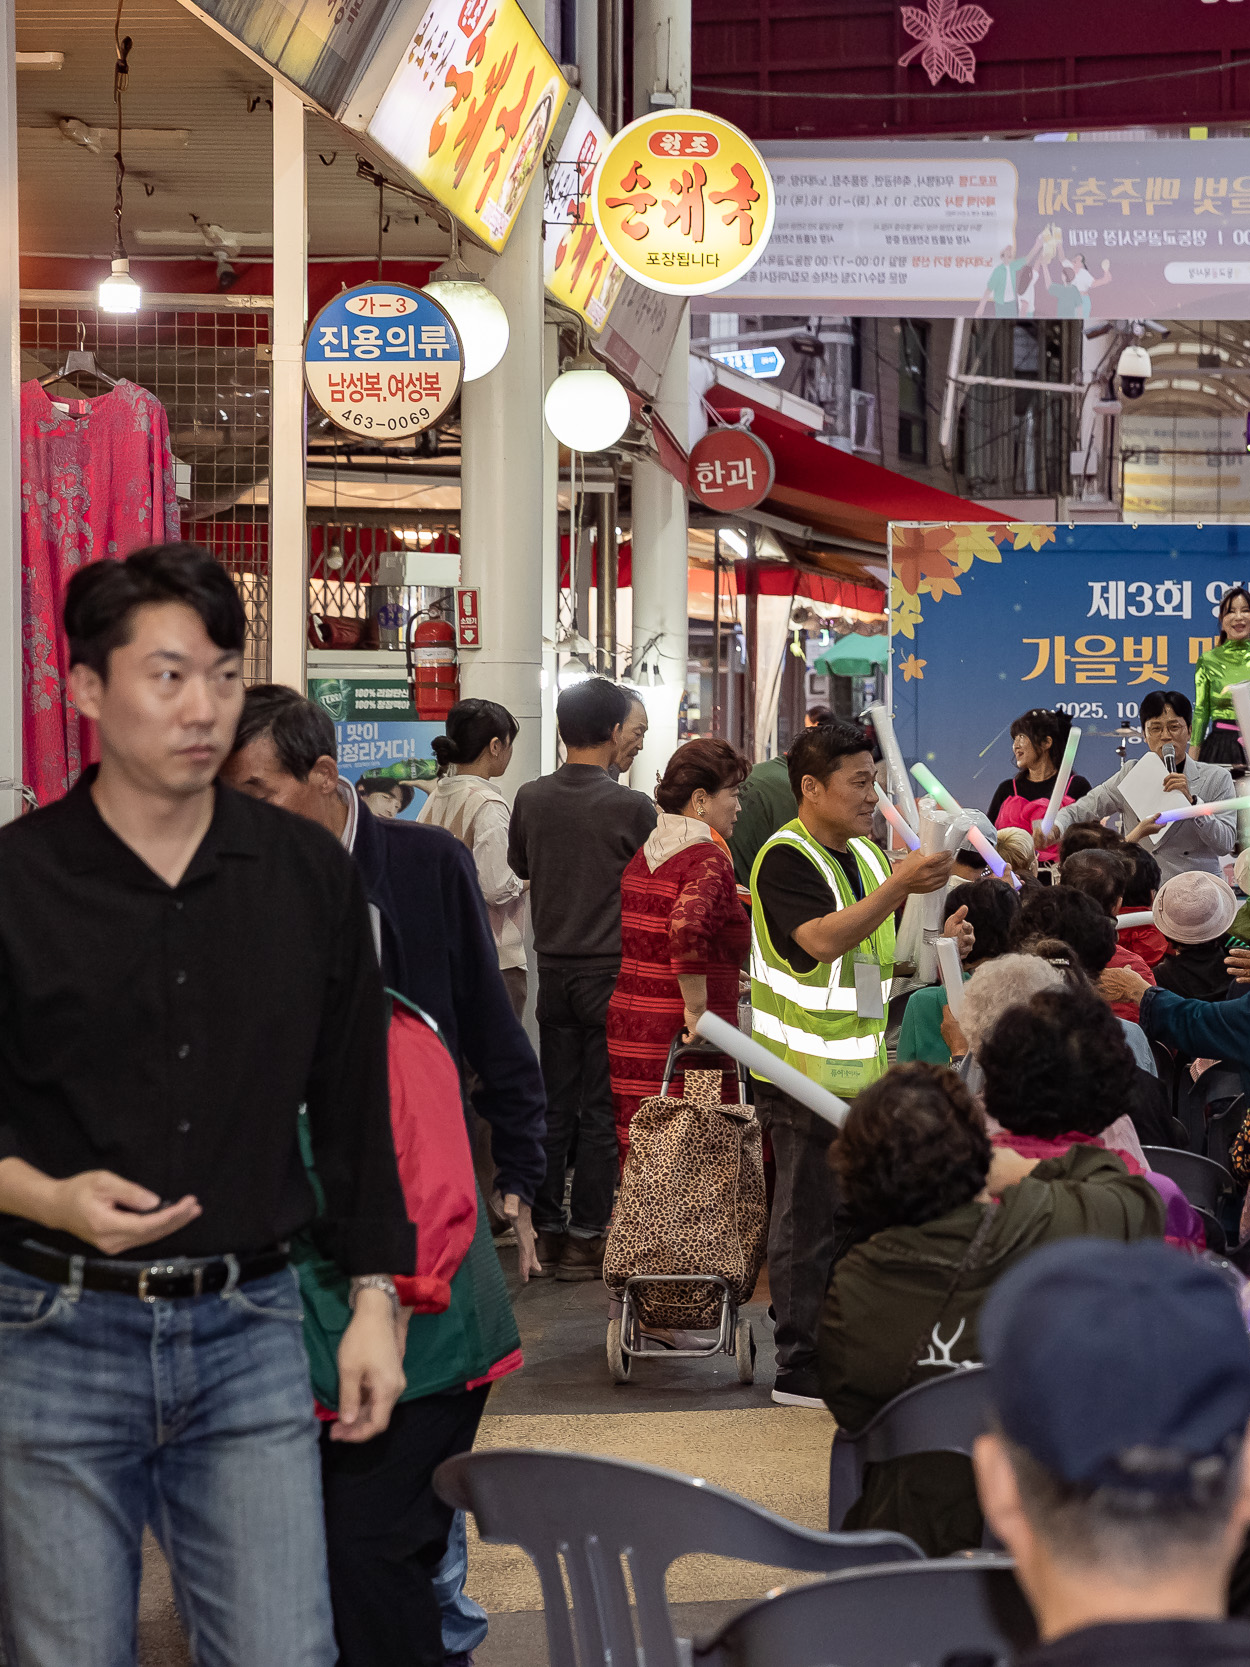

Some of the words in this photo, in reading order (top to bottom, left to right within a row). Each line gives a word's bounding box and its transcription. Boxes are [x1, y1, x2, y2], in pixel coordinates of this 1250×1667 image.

[659, 133, 709, 156] 원조
[605, 160, 760, 245] 순대국
[646, 252, 720, 268] 포장됩니다
[358, 296, 407, 315] 가-3
[318, 325, 450, 359] 진용의류
[341, 407, 430, 431] 463-0069
[695, 457, 757, 494] 한과
[1086, 580, 1192, 620] 제3회
[1021, 634, 1169, 686] 가을빛
[355, 688, 376, 698] 100%
[355, 701, 376, 710] 100%
[347, 723, 378, 742] 맛이
